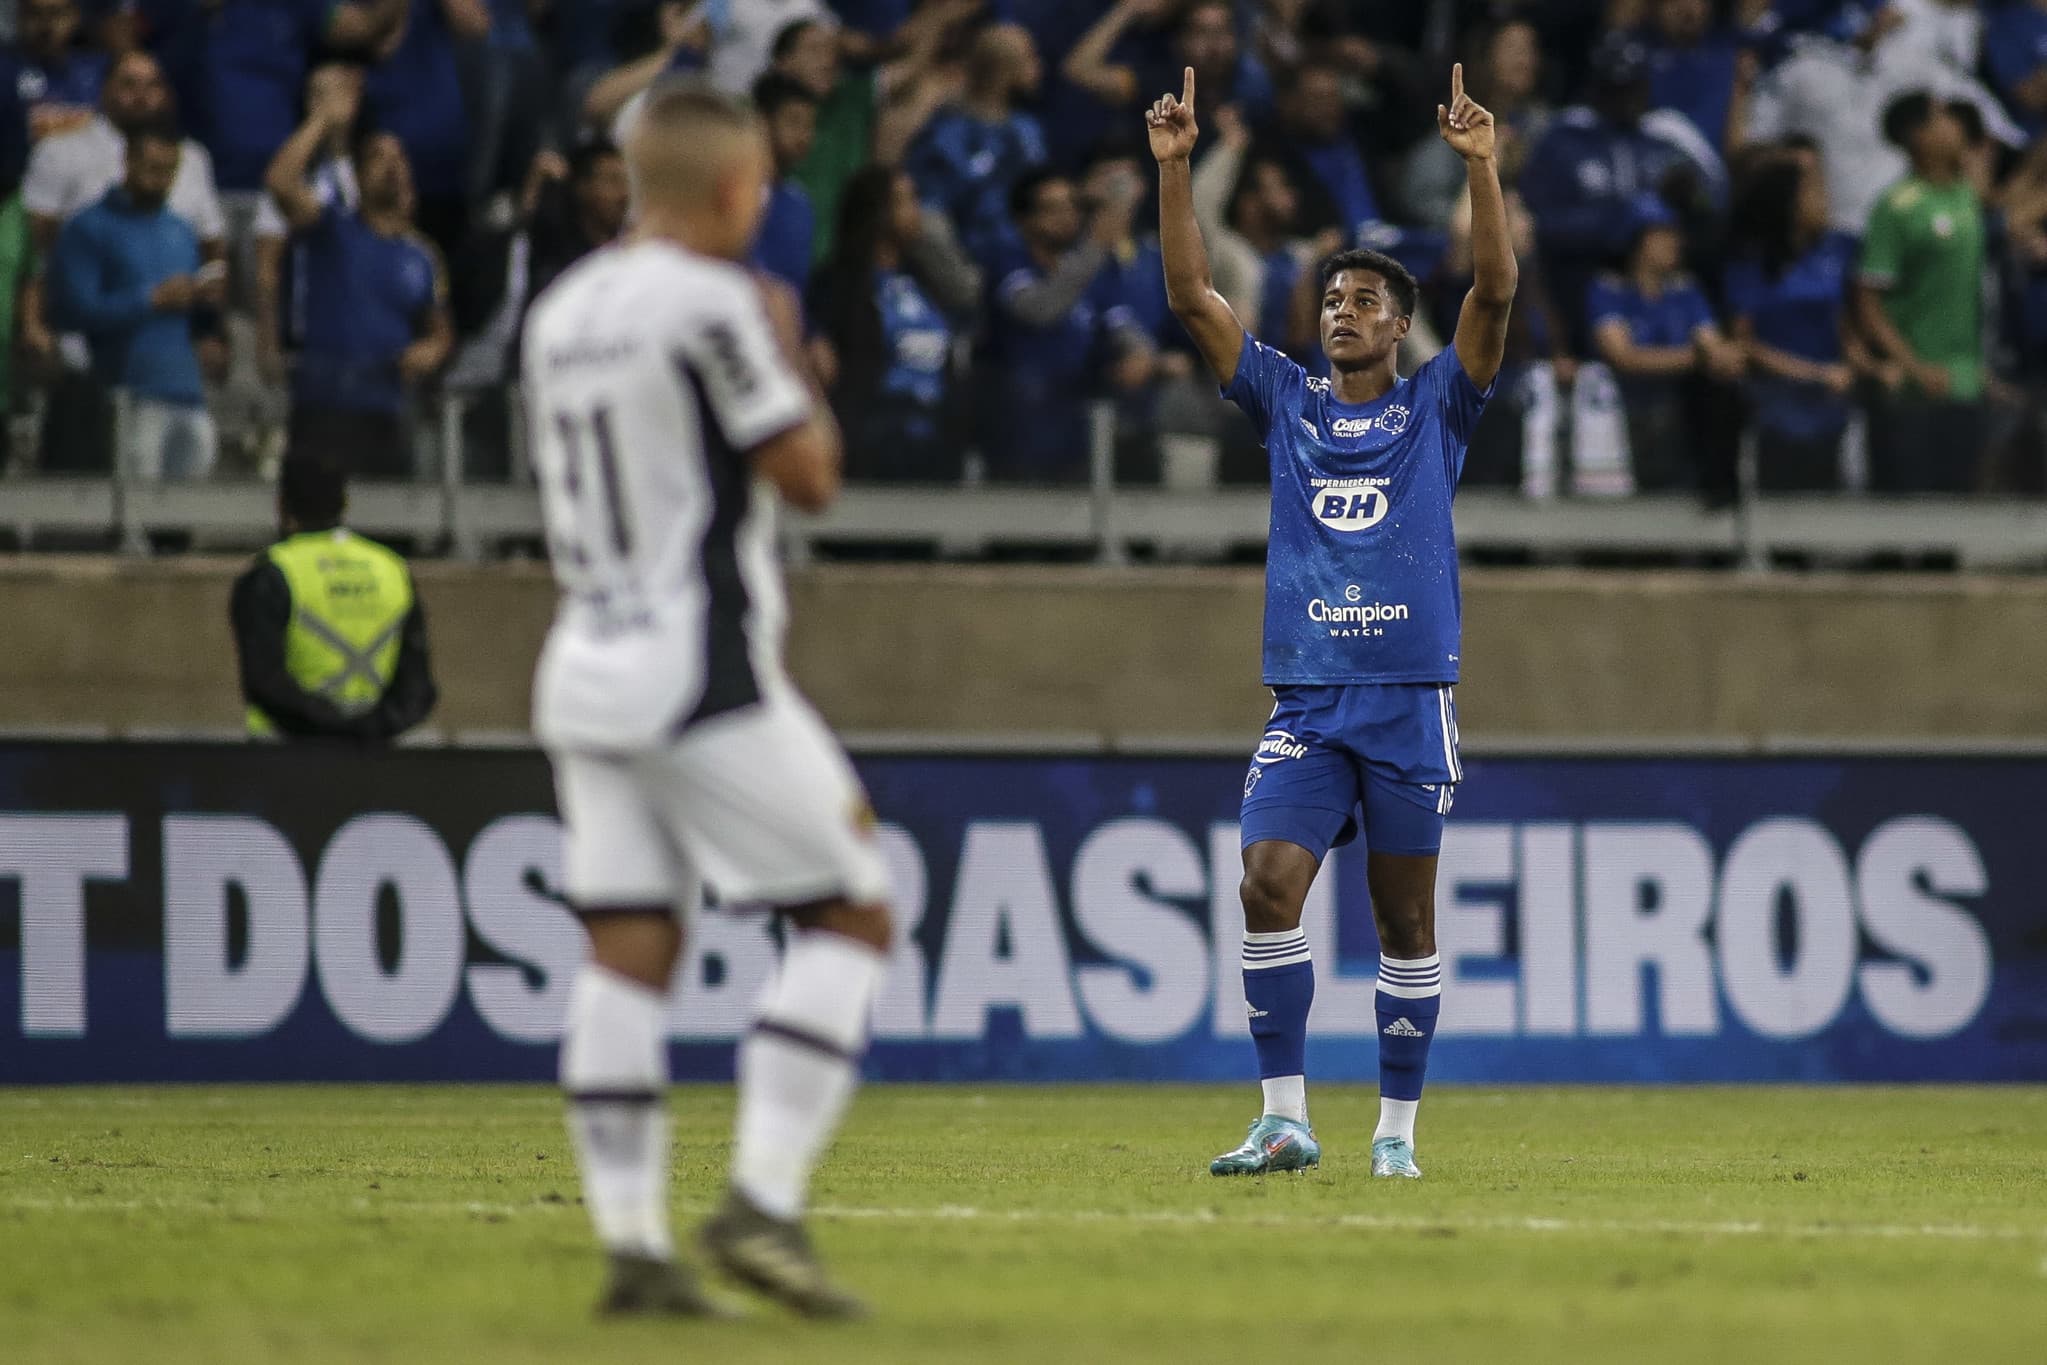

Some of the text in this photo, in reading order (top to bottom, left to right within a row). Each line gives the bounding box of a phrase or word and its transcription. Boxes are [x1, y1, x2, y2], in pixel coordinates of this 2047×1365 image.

[1310, 477, 1391, 488] SUPERMERCADOS
[1319, 493, 1378, 519] BH
[1308, 598, 1409, 628] Champion
[1329, 628, 1384, 637] WATCH
[162, 811, 598, 1044] DOS
